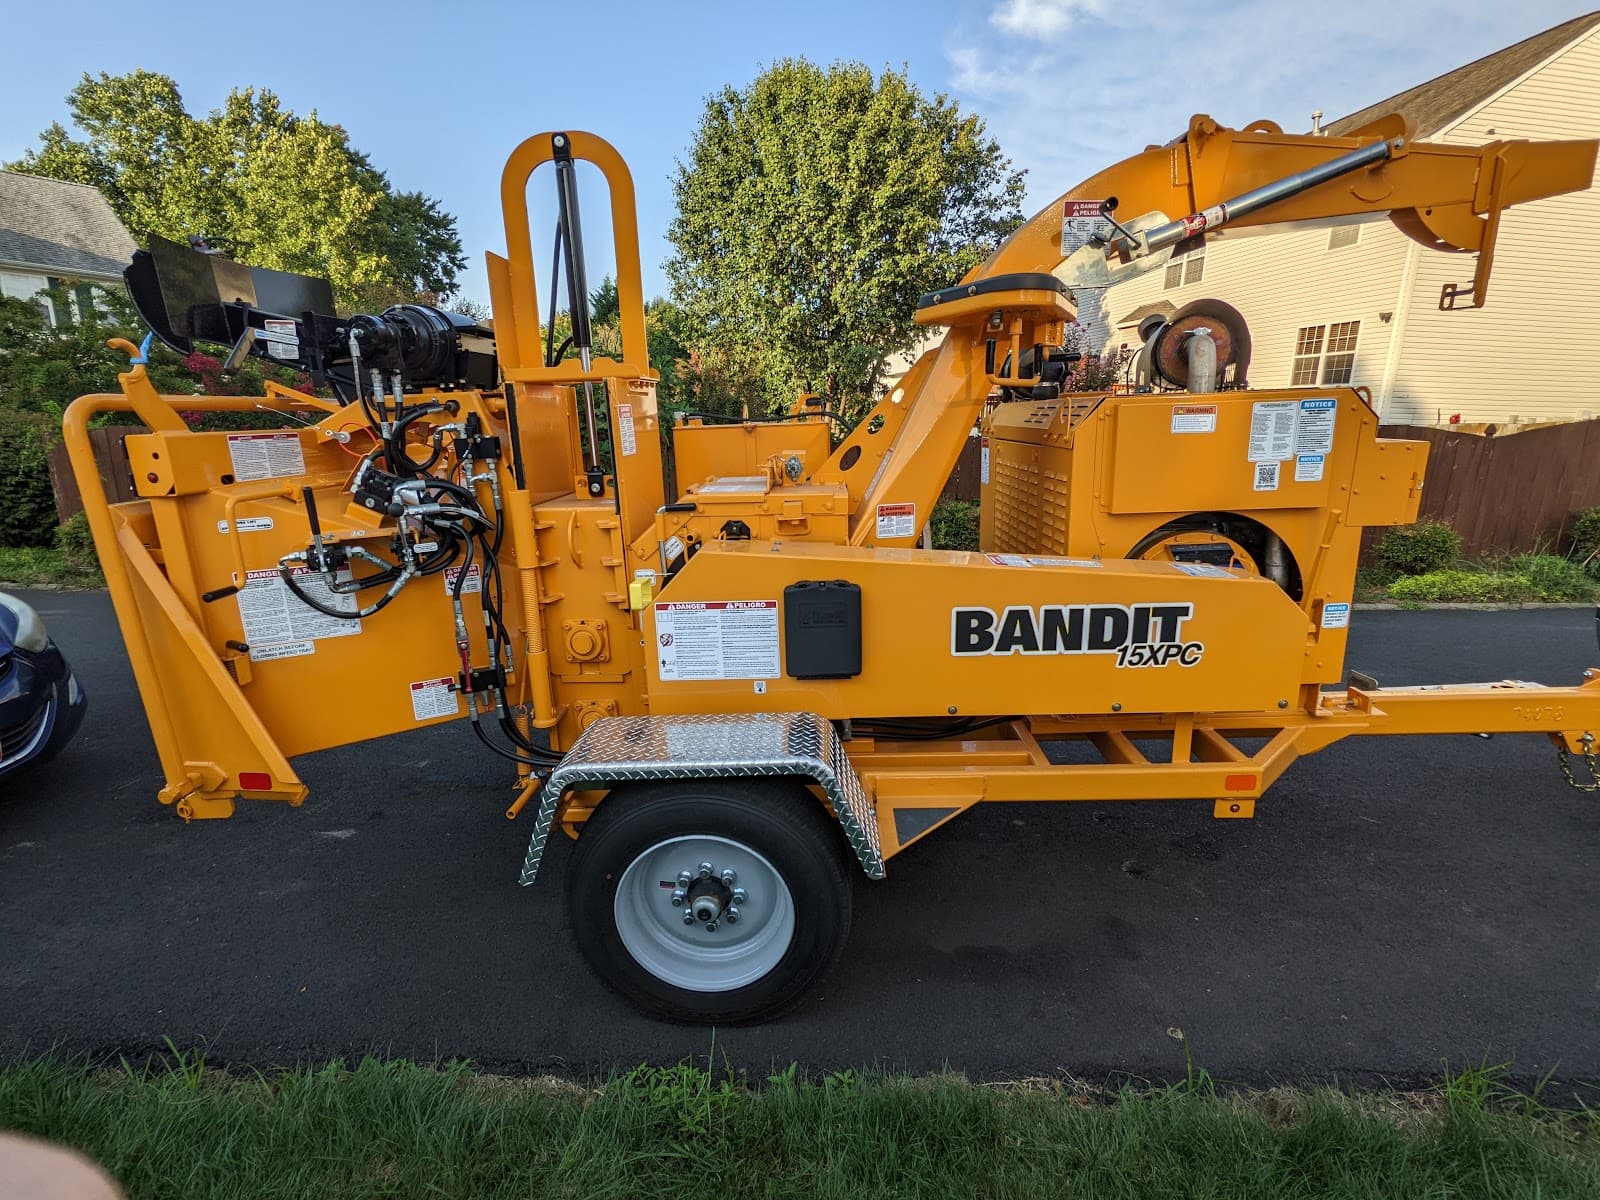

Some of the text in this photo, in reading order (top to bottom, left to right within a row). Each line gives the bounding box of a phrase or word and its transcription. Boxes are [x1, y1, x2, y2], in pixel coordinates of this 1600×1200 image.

[1304, 400, 1333, 408] NOTICE
[247, 570, 280, 579] DANGE
[953, 603, 1192, 654] BANDIT
[1116, 643, 1203, 667] 15XPC
